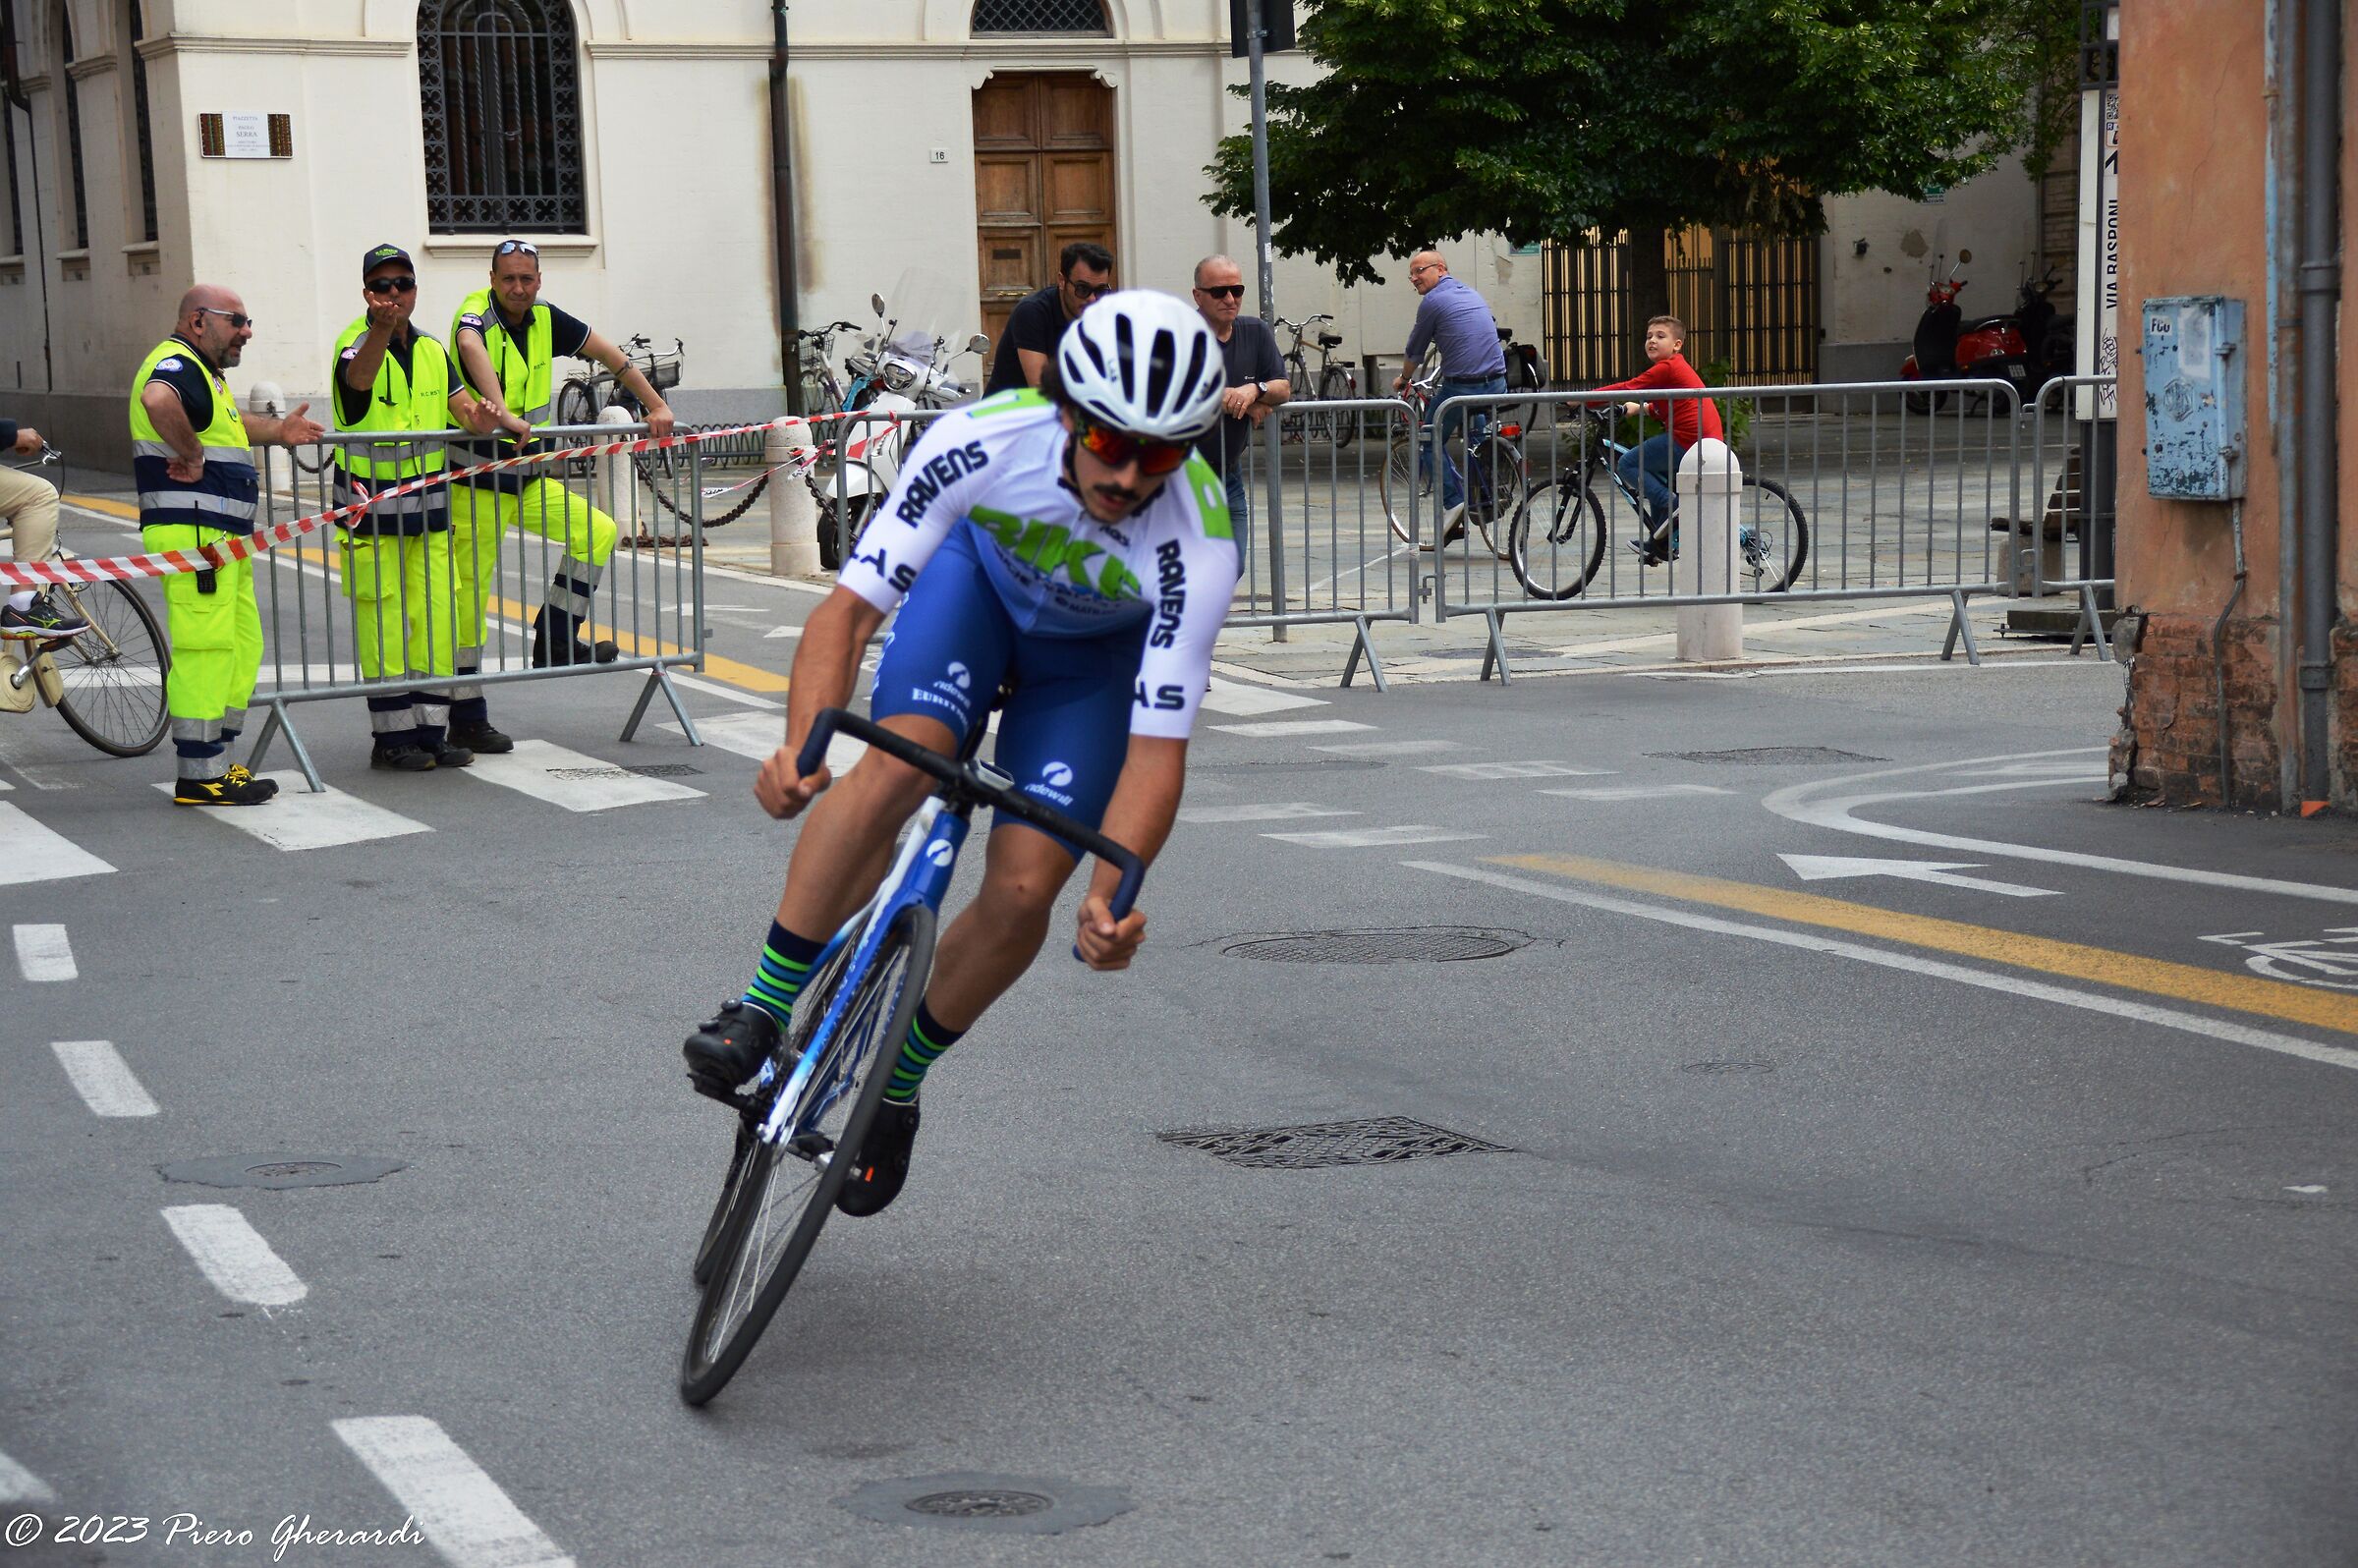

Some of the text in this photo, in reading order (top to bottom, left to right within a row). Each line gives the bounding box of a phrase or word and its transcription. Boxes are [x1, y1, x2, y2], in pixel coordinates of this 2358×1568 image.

[935, 151, 945, 160] 16
[2105, 282, 2118, 309] VIA
[896, 439, 989, 530] RAVENS
[1150, 538, 1187, 649] RAVENS
